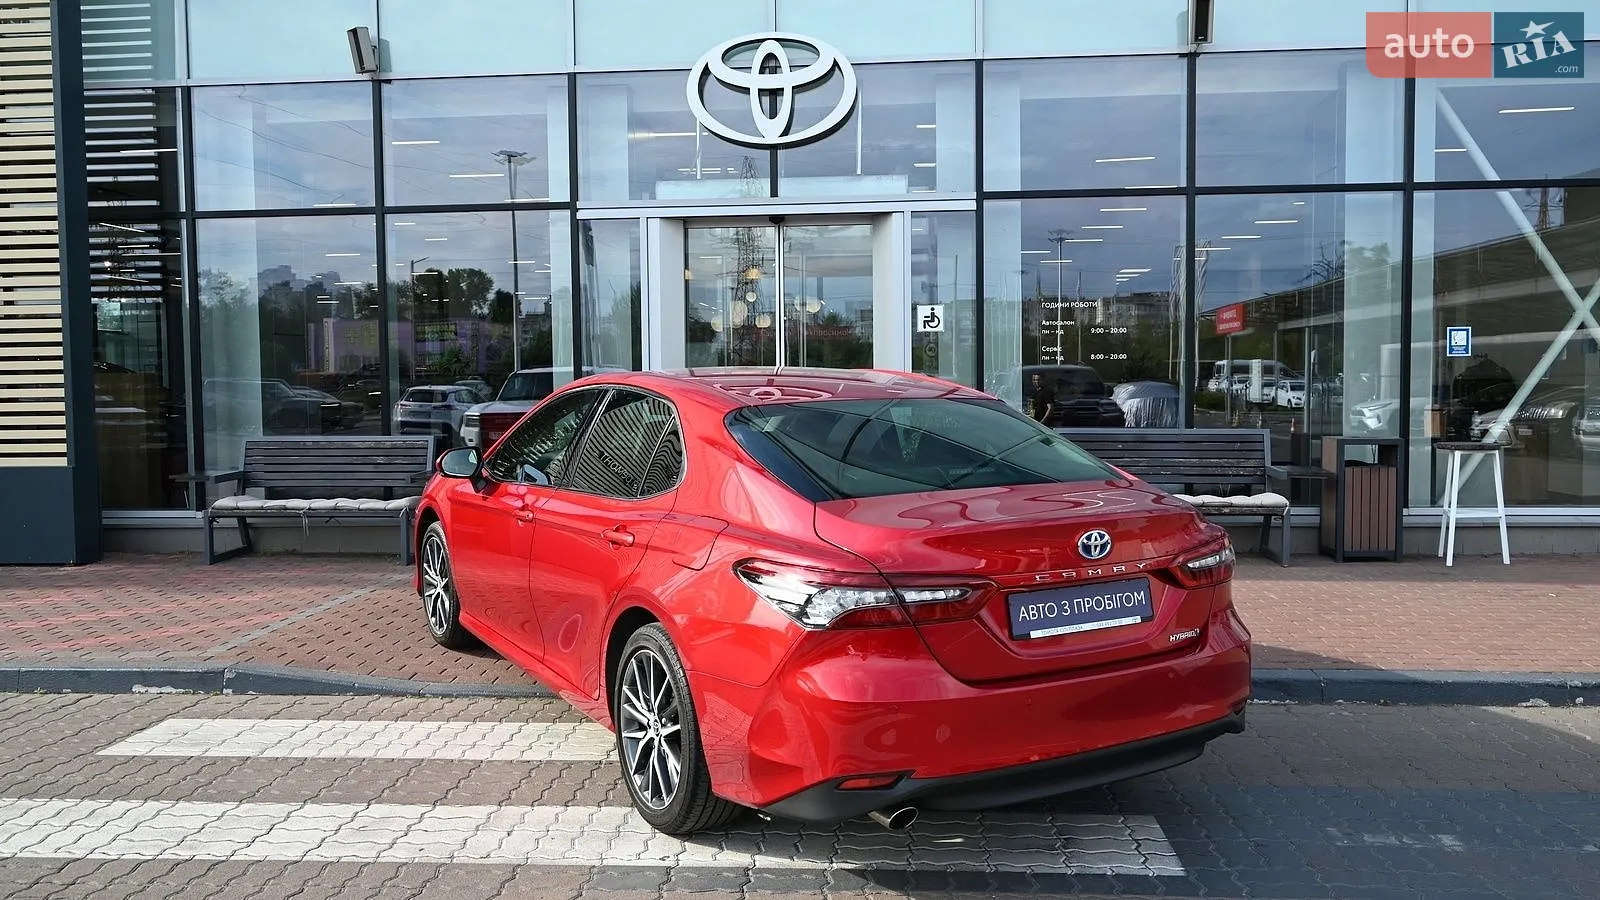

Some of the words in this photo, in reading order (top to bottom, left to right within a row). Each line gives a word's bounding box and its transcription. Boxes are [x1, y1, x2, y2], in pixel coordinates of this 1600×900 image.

[1035, 562, 1149, 581] CAMRY
[1019, 602, 1057, 622] АВТО
[1074, 591, 1145, 613] ПРОБІГОМ
